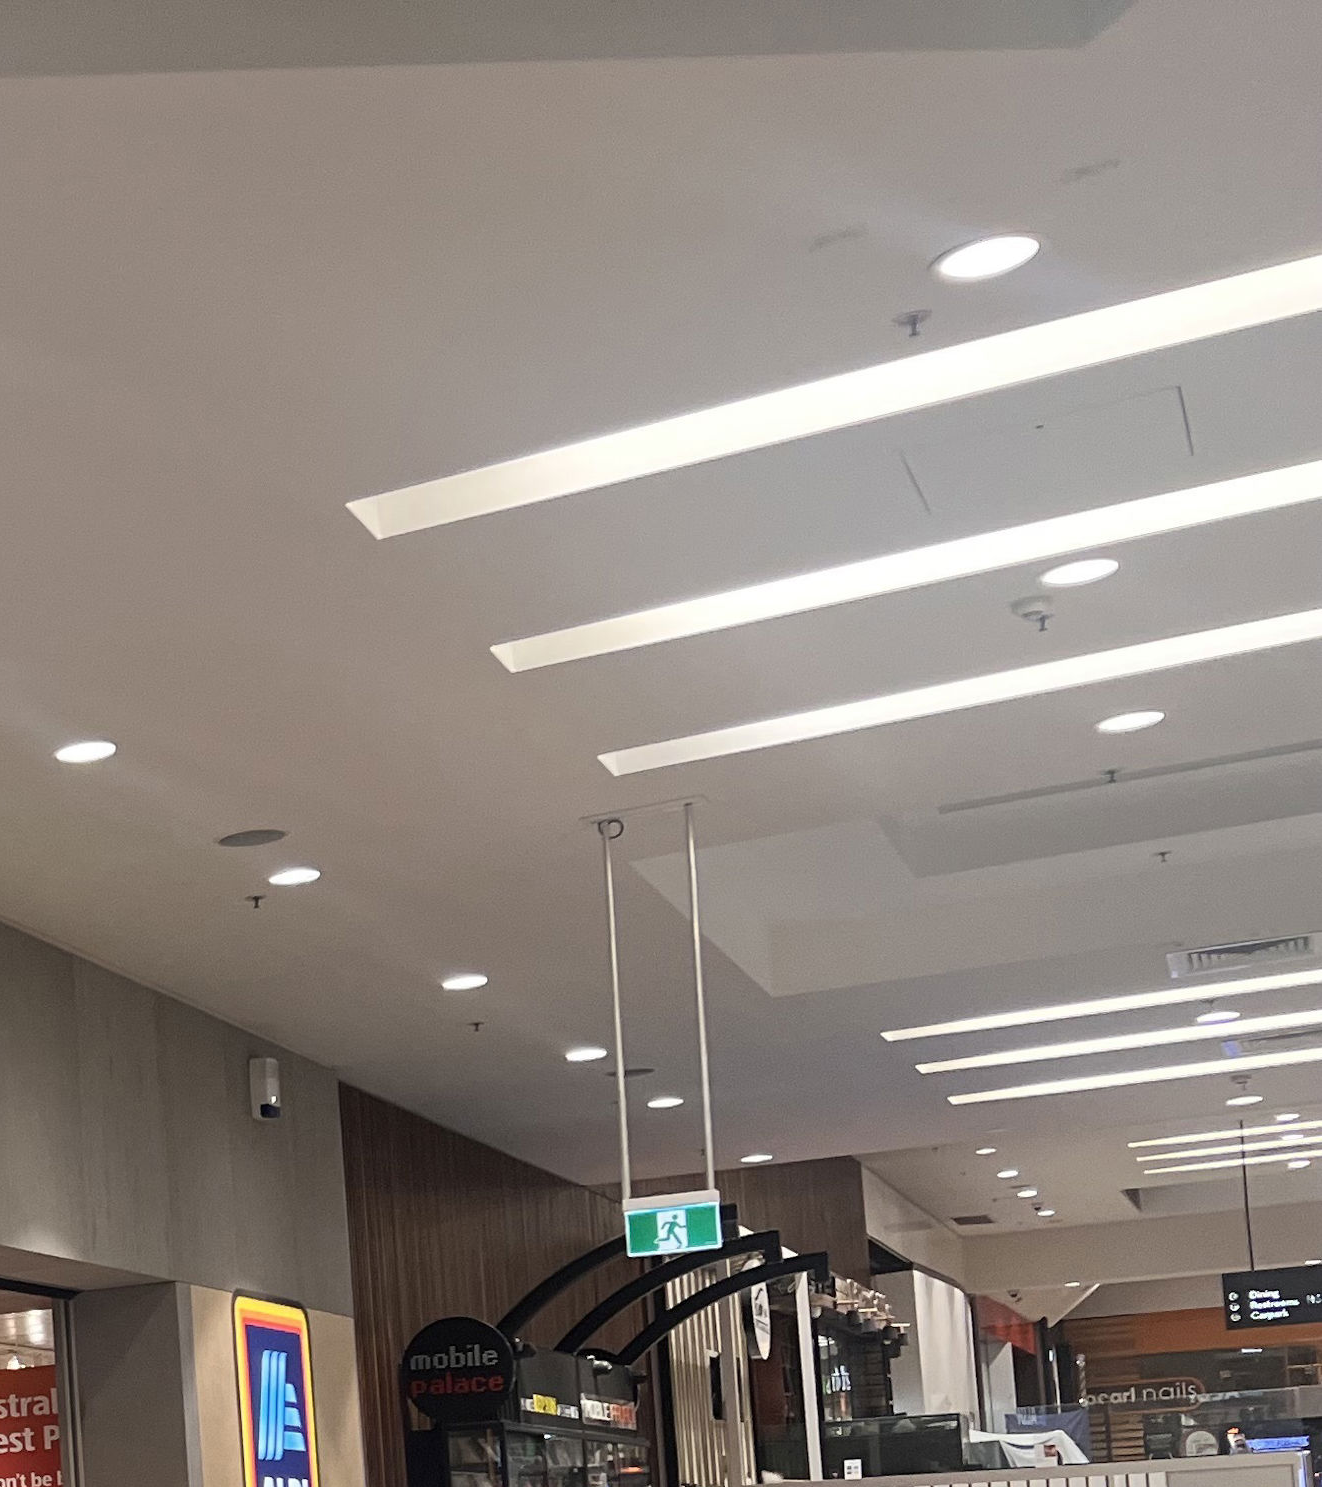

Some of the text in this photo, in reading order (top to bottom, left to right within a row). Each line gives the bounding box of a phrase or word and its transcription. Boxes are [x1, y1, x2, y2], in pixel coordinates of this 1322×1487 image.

[410, 1343, 498, 1371] mobile
[412, 1372, 505, 1398] palace
[1142, 1382, 1197, 1402] nails
[43, 1424, 61, 1450] P
[30, 1471, 53, 1487] be
